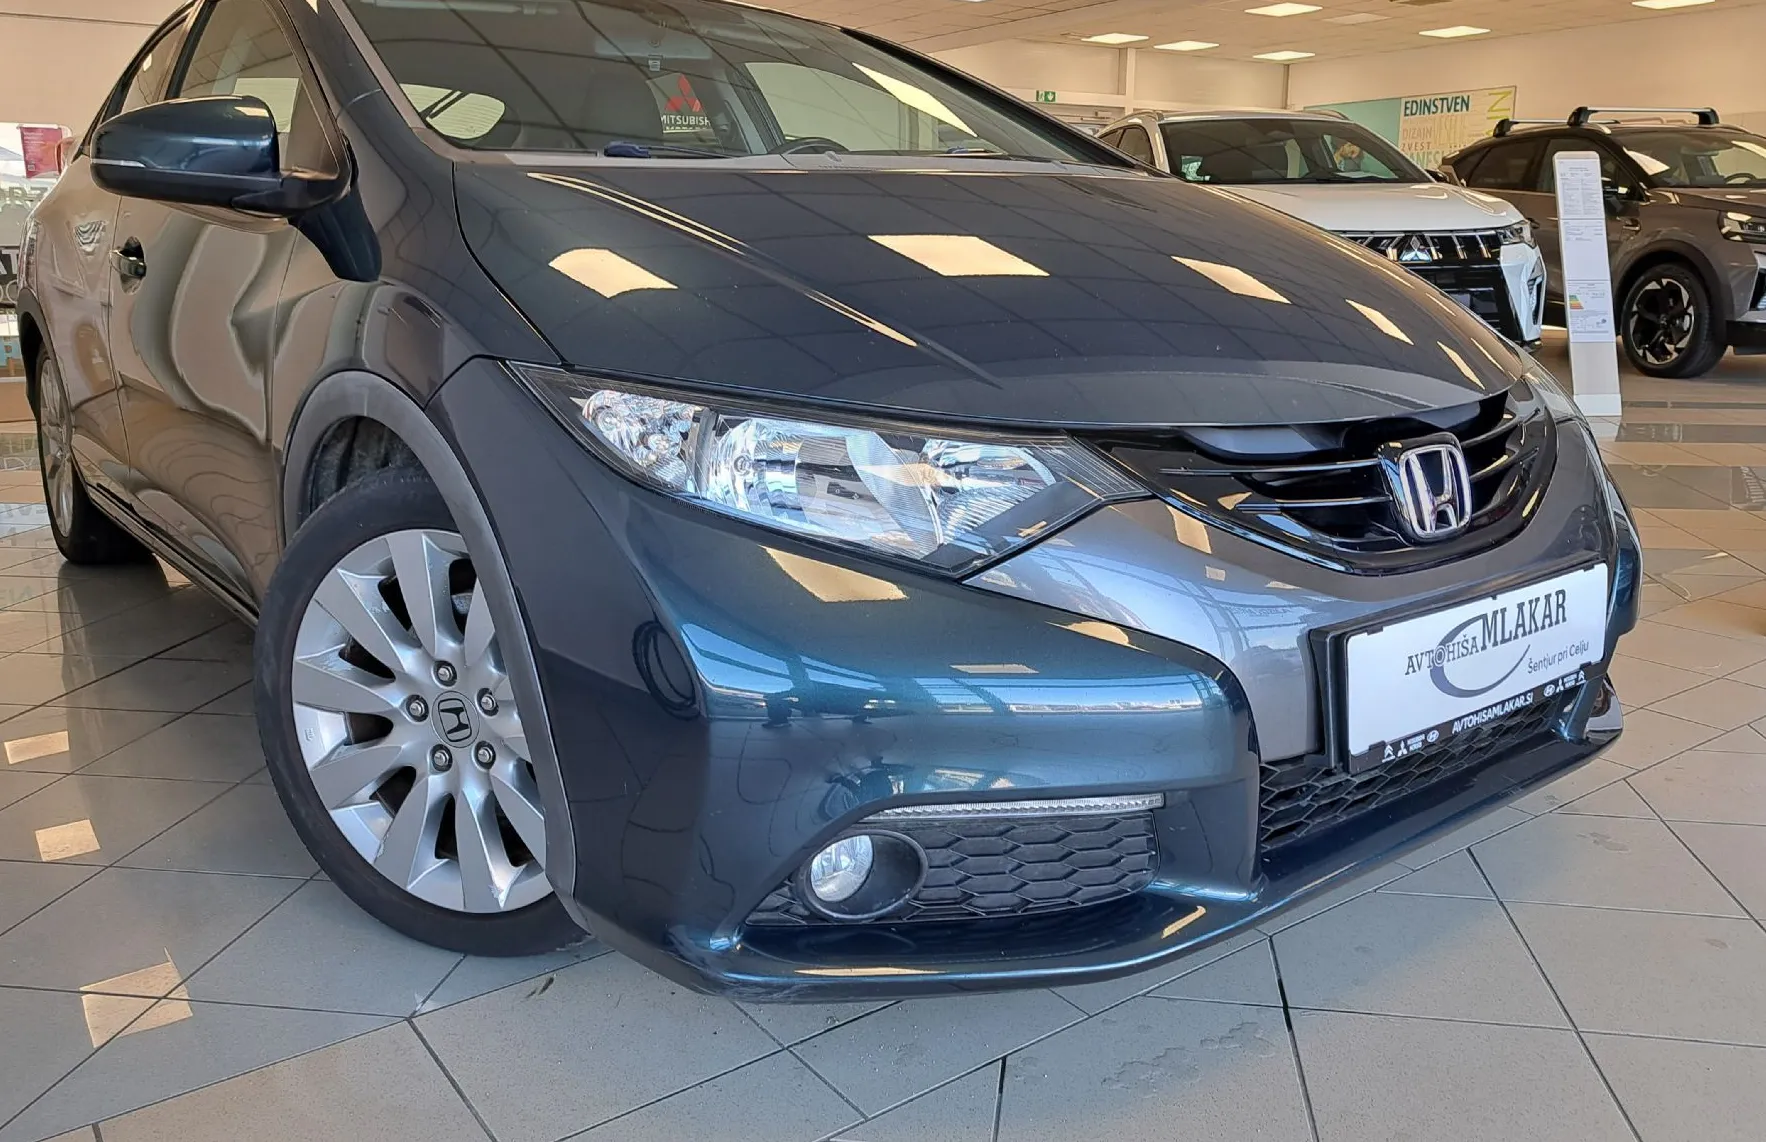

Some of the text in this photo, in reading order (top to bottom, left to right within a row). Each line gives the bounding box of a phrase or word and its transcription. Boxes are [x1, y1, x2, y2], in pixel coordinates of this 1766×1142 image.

[1404, 95, 1470, 117] EDINSTVEN
[1405, 589, 1567, 675] AVTOHIŠA MLAKAR
[1528, 640, 1589, 673] Šentjur pri Celju
[1452, 692, 1533, 734] AVTOHISAMLAKAR.SI
